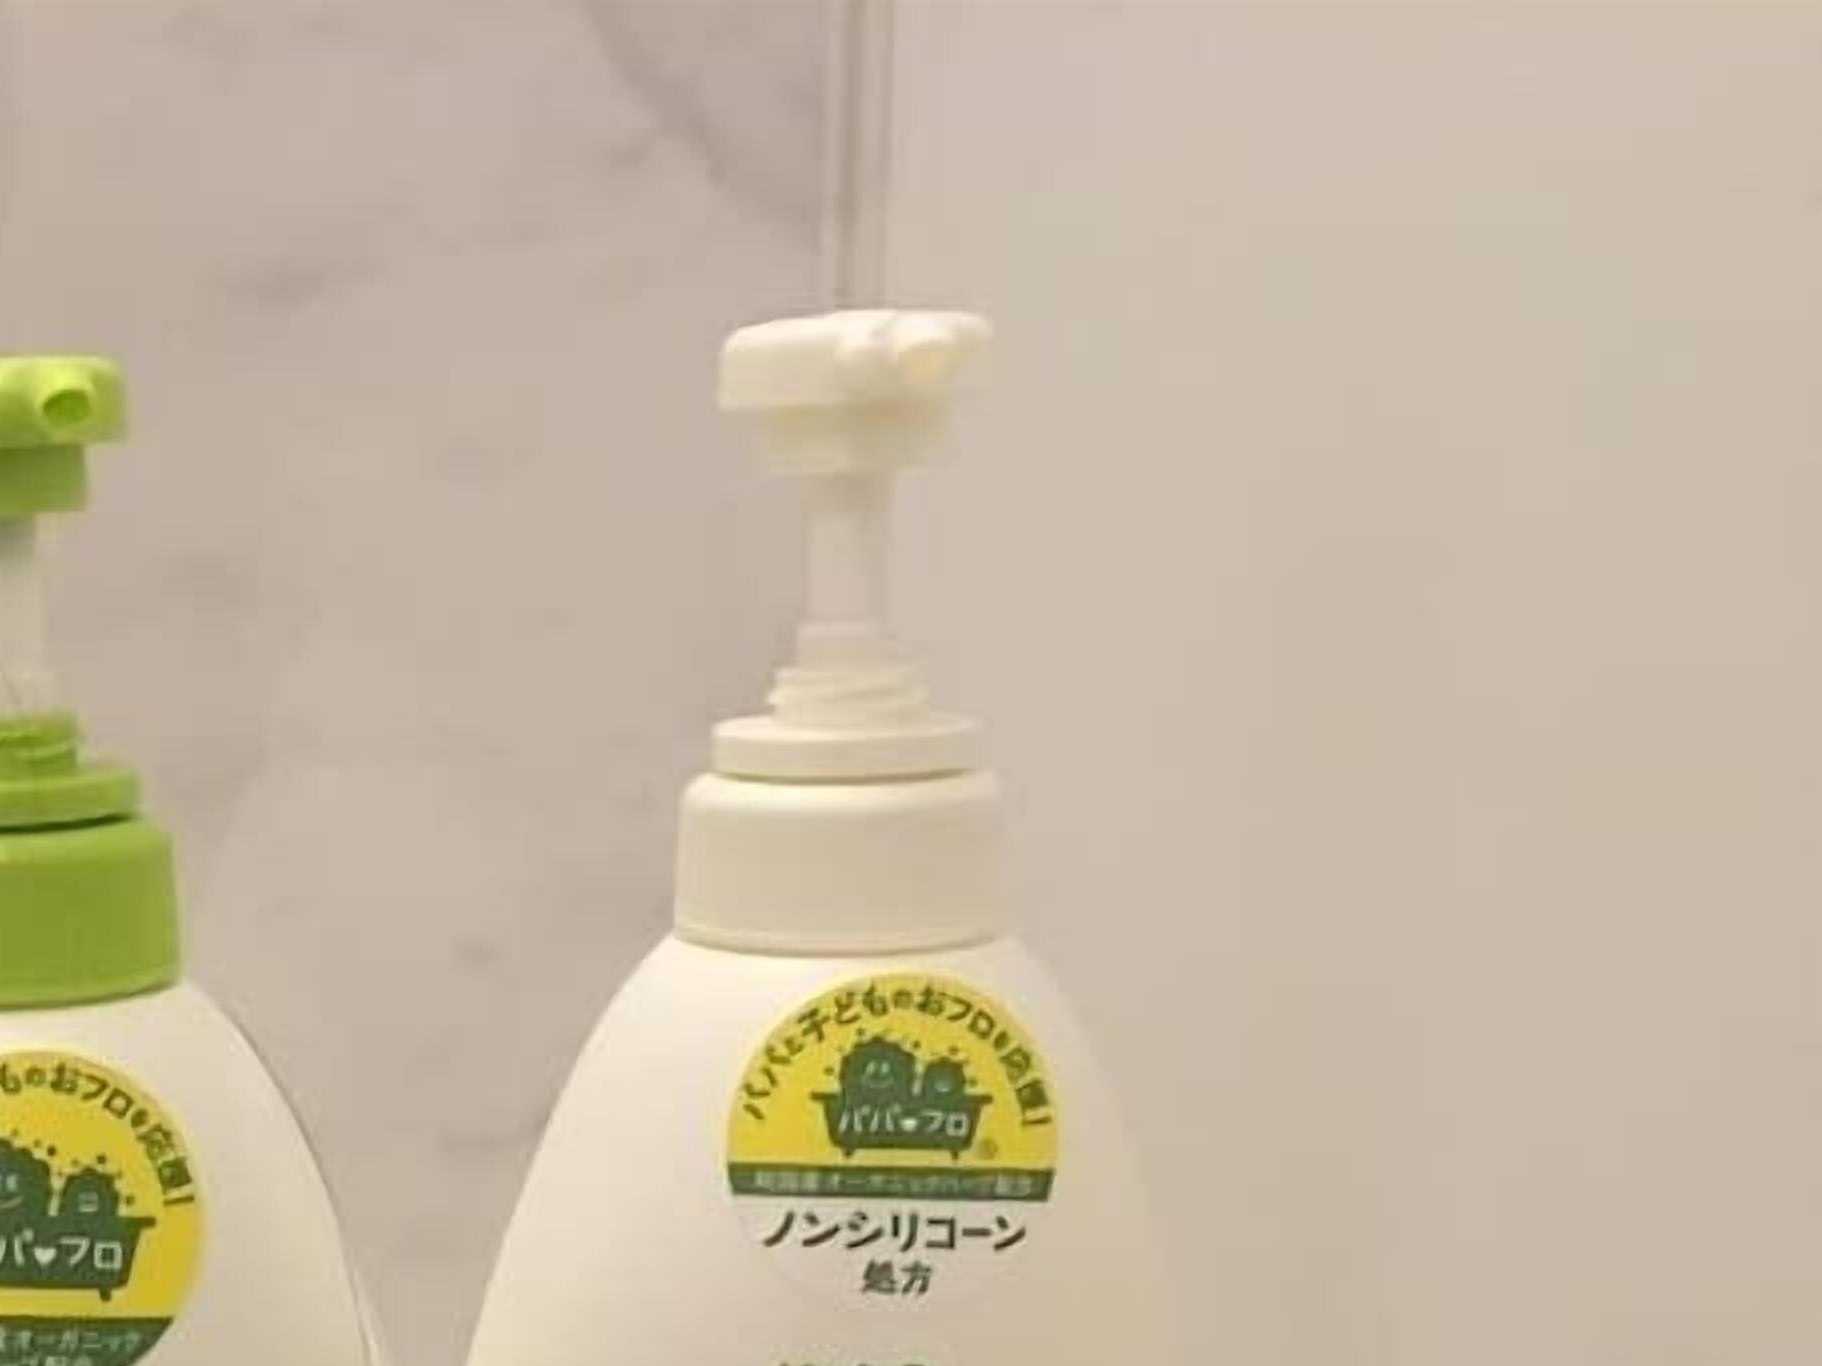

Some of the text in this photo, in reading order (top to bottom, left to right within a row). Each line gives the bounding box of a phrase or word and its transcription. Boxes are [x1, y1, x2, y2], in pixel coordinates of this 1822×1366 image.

[762, 1211, 1026, 1252] ノンシリコーン
[860, 1258, 933, 1296] 処方
